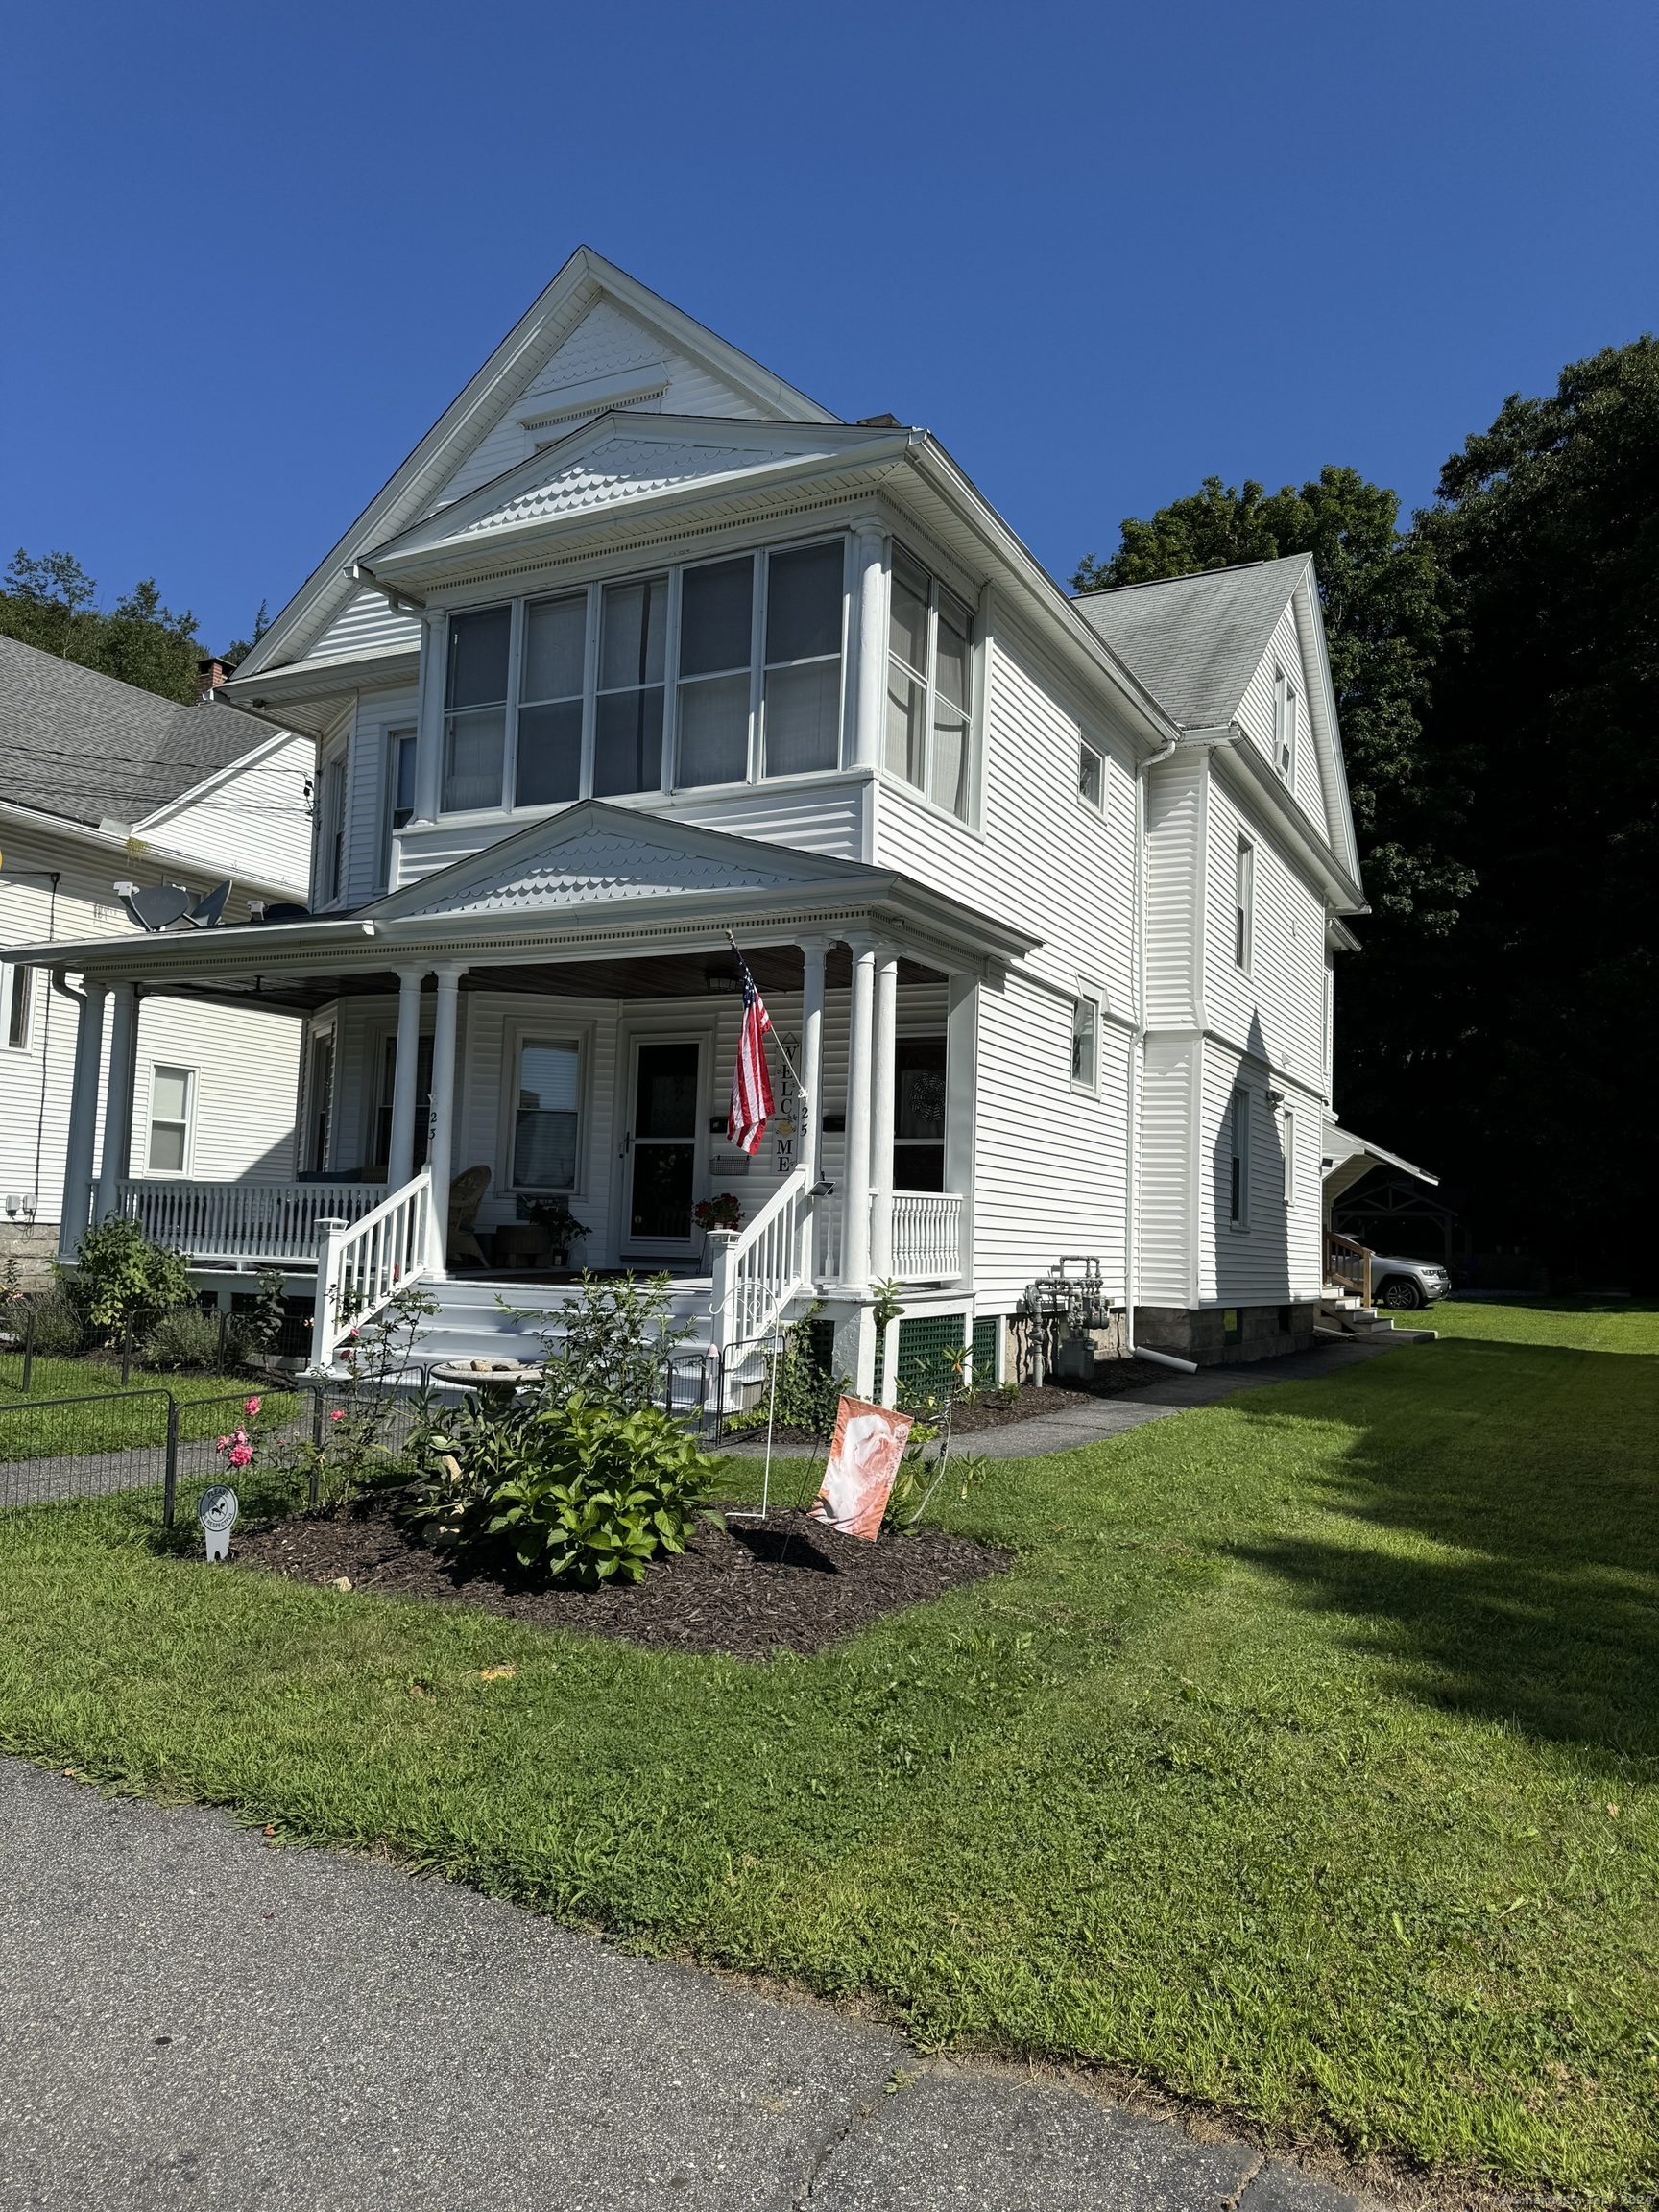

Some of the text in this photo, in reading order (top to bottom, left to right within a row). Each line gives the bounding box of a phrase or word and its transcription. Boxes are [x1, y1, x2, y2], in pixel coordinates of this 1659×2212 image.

[776, 1046, 798, 1172] WELCME
[800, 1106, 808, 1137] 25
[428, 1112, 437, 1140] 23
[206, 1488, 230, 1499] PLEASE
